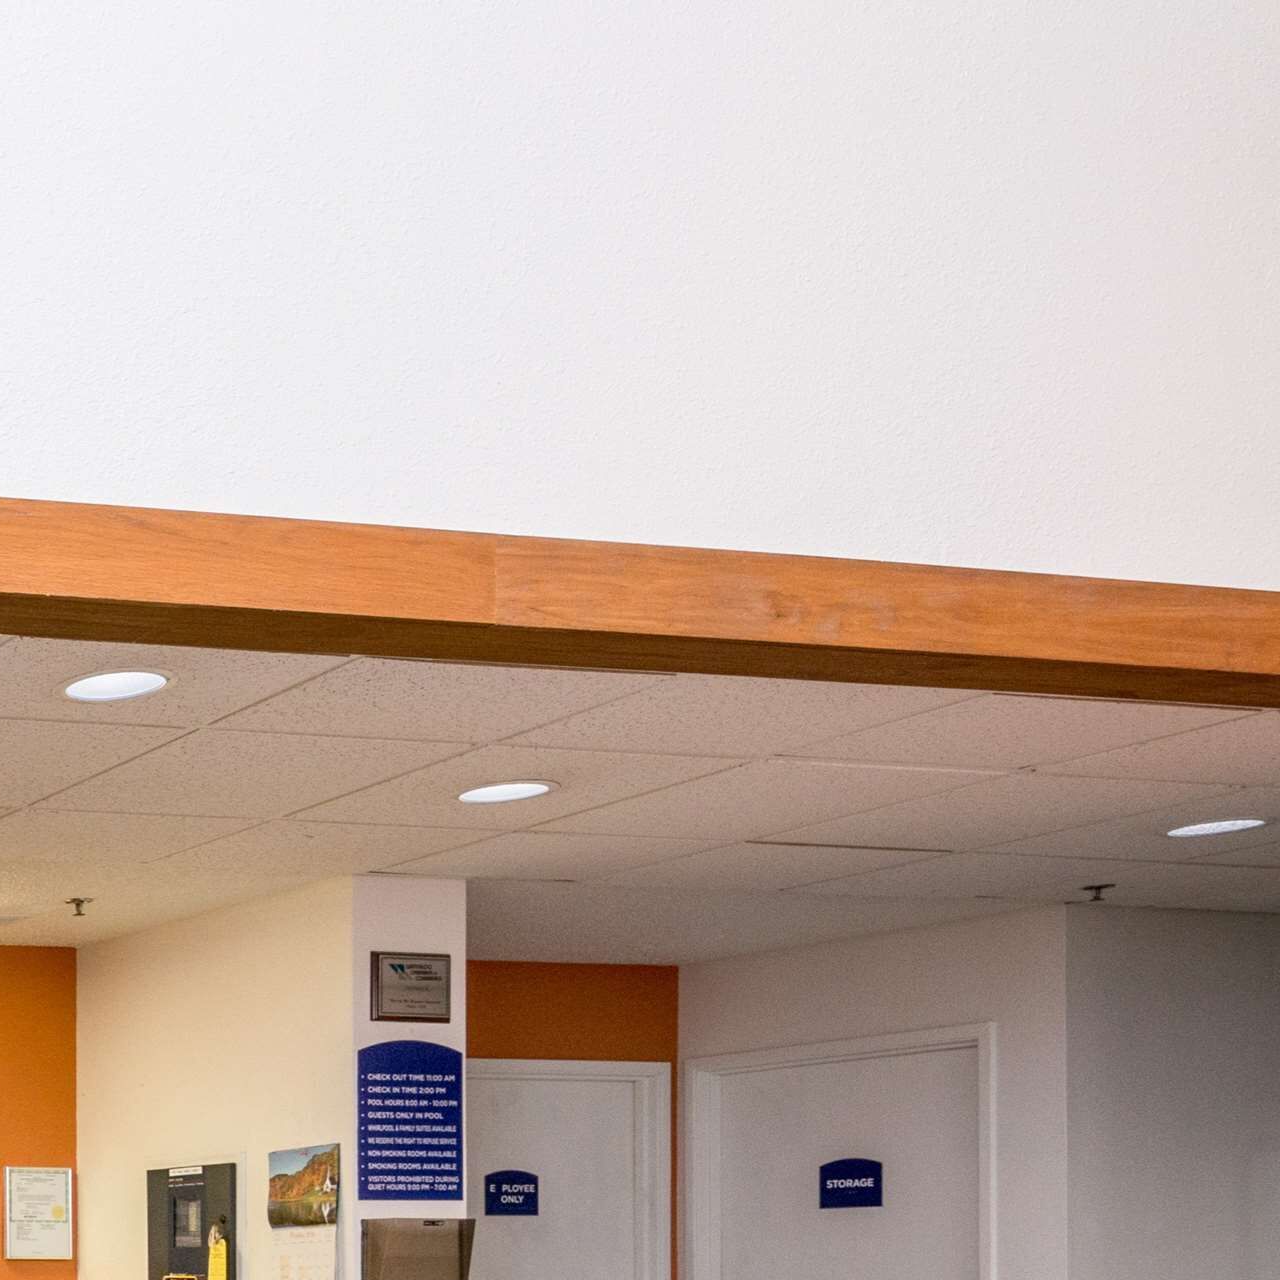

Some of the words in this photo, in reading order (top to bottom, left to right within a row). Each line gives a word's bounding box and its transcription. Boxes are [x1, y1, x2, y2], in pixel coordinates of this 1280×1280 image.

[408, 1074, 425, 1082] TIME
[426, 1074, 442, 1082] 11:00
[444, 1074, 456, 1082] AM
[368, 1086, 391, 1094] CHECK
[424, 1112, 444, 1120] POOL
[368, 1124, 394, 1132] WHIRLPOOL
[428, 1150, 456, 1158] AVAILABLE
[826, 1178, 874, 1189] STORAGE
[500, 1195, 524, 1203] ONLY
